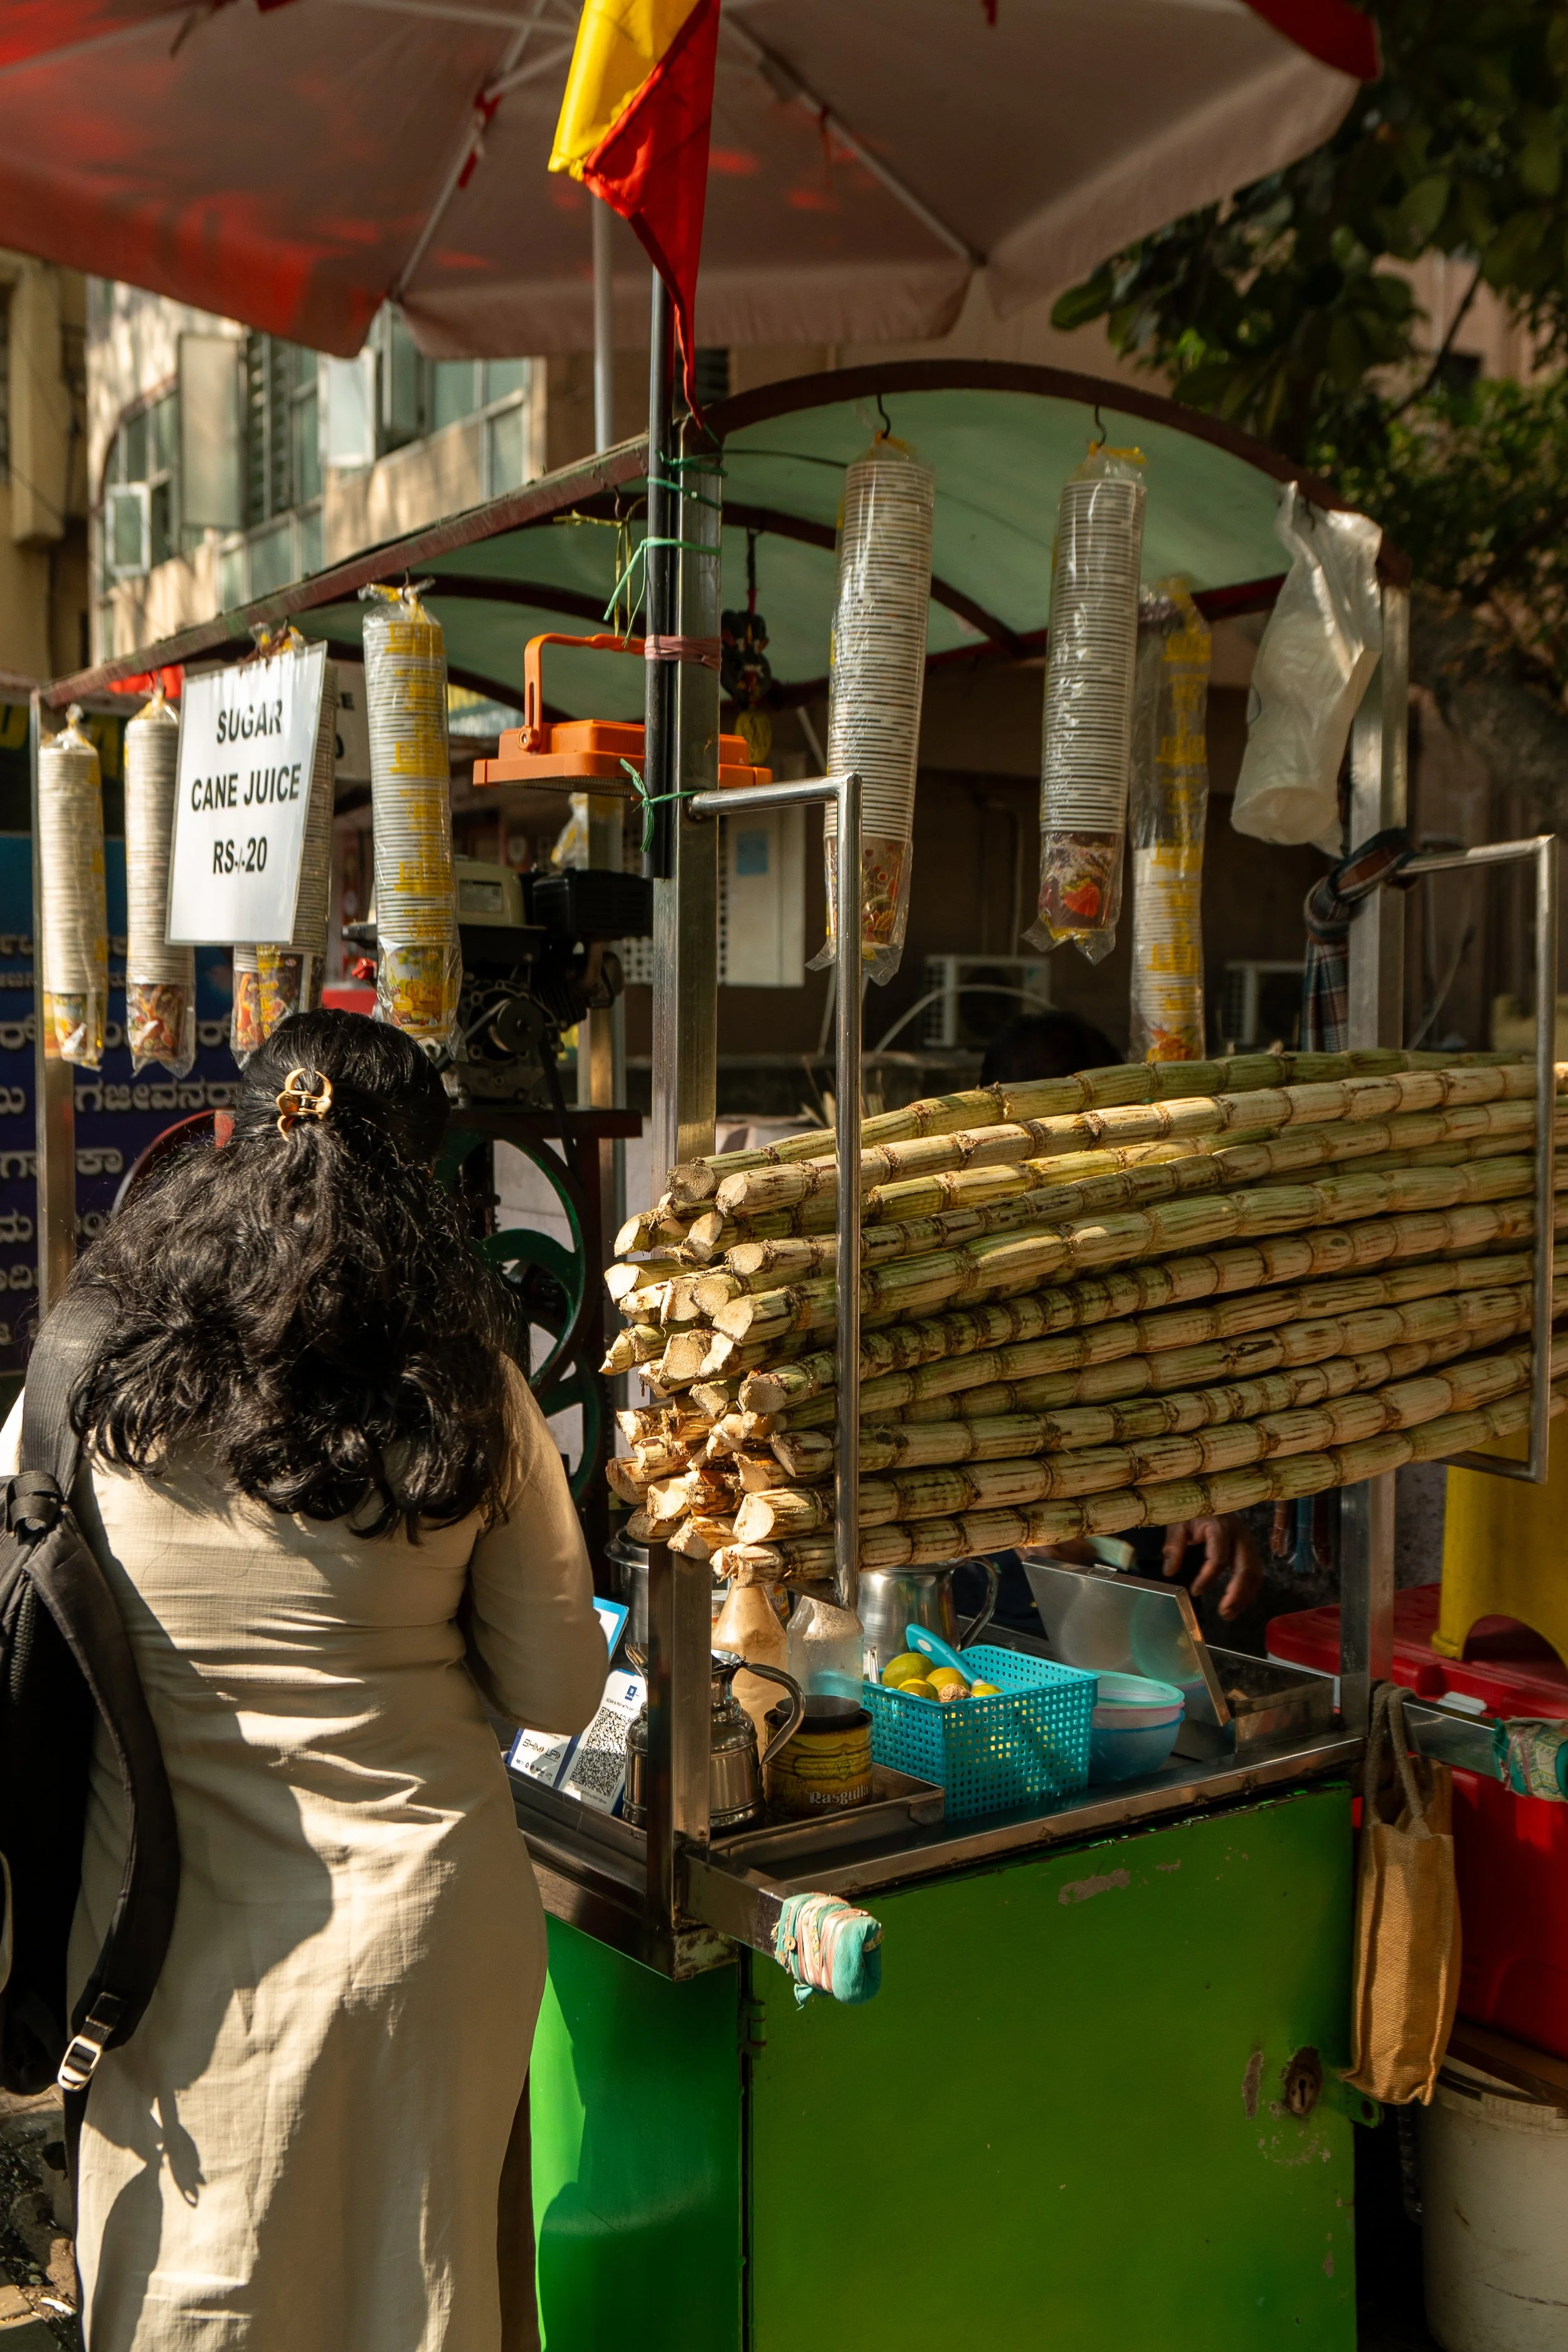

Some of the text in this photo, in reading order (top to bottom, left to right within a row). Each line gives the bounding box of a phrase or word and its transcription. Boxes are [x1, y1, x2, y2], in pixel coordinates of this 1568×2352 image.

[216, 699, 282, 743] SUGAR
[191, 763, 302, 811] CANE JUICE
[809, 1784, 869, 1805] Rasgulla
